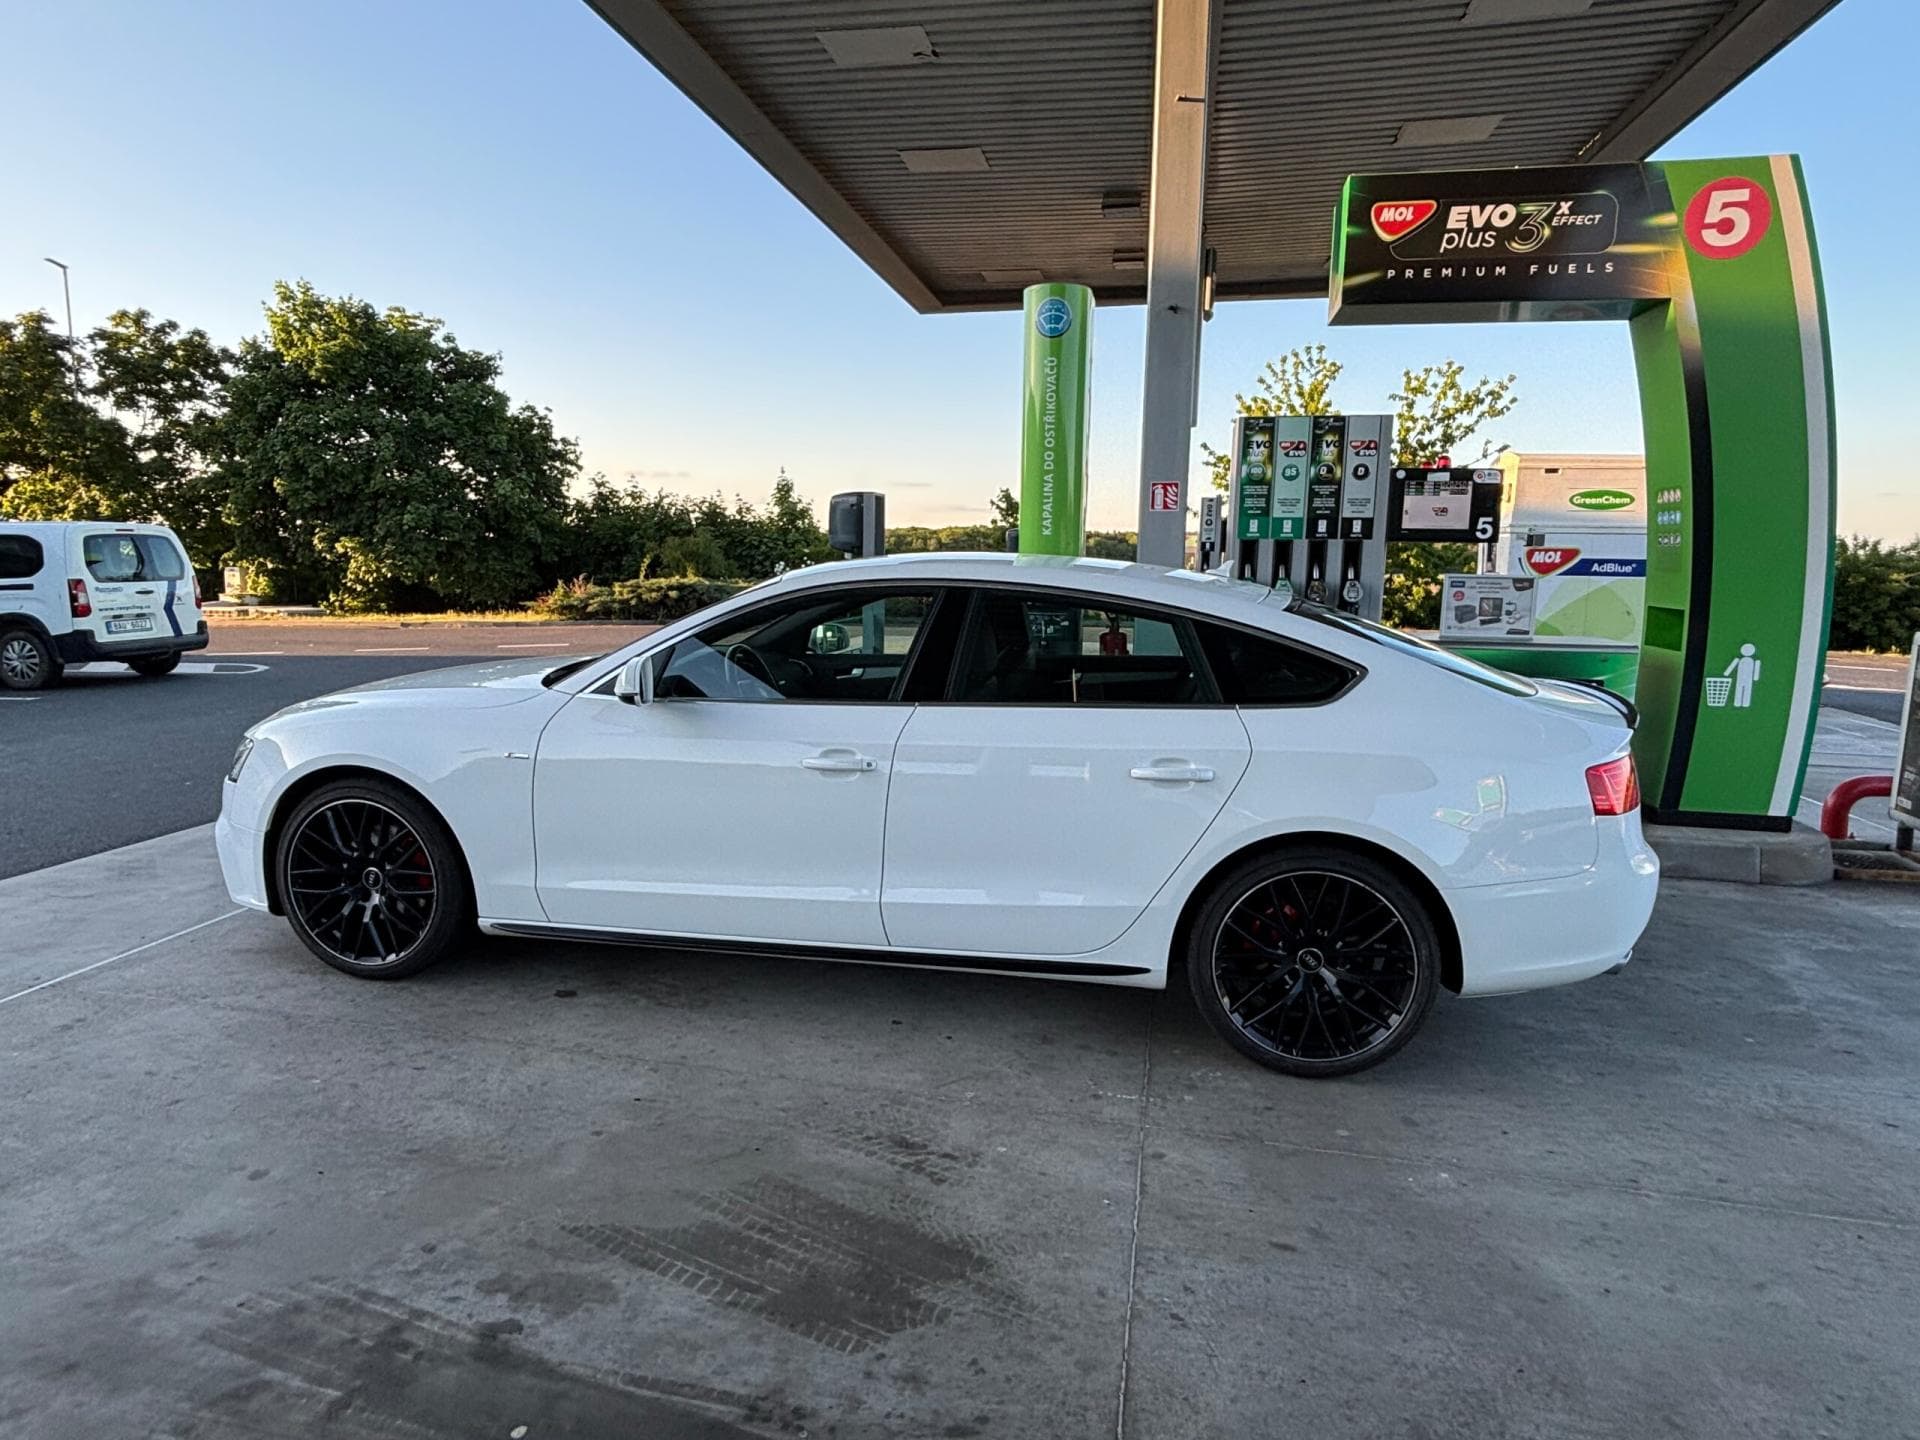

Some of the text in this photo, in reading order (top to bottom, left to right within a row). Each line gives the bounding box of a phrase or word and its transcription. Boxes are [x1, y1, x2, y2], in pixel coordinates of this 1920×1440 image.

[1380, 206, 1414, 222] MOL
[1446, 203, 1517, 229] EVO
[1551, 214, 1603, 226] EFFECT
[1701, 188, 1751, 247] 5
[1440, 226, 1497, 253] plus
[1387, 262, 1614, 279] PREMIUM FUELS
[1046, 450, 1055, 471] DO
[1284, 467, 1297, 477] 95
[1042, 472, 1055, 536] KAPALINA
[1573, 495, 1631, 505] GreenChem
[1475, 516, 1494, 540] 5
[1531, 551, 1562, 564] MOL
